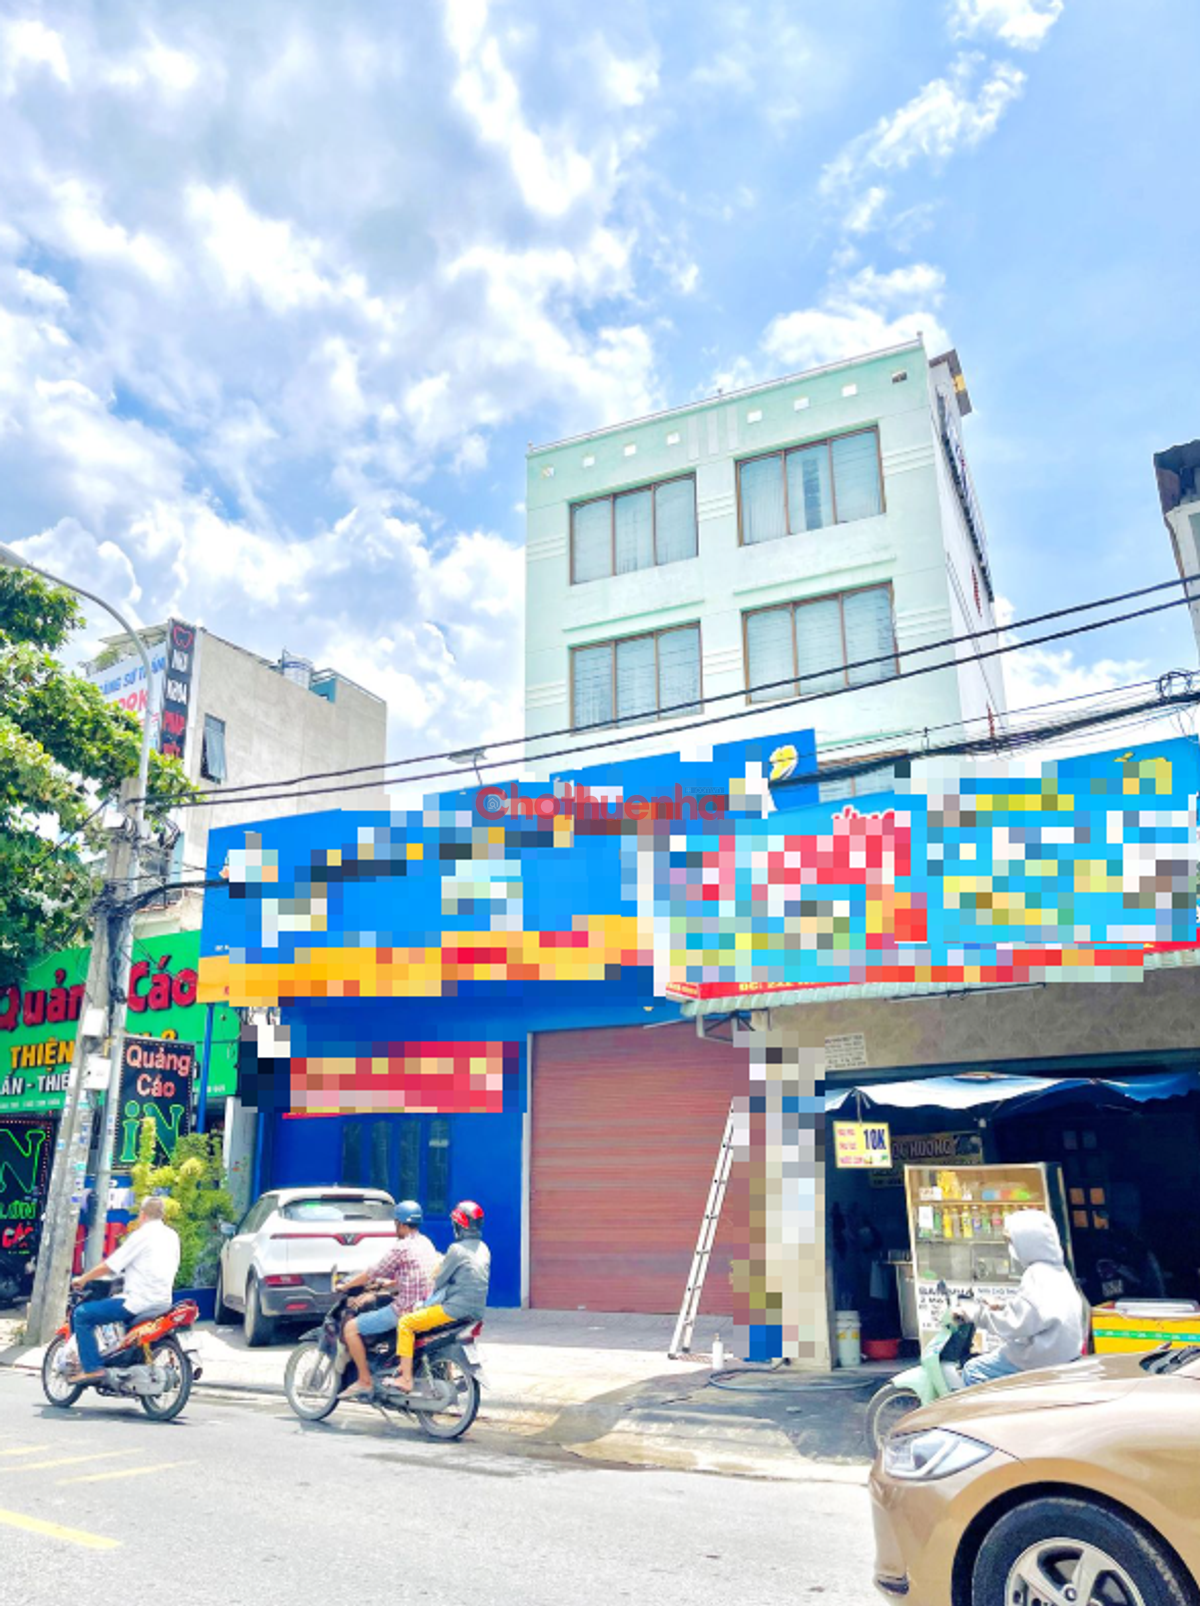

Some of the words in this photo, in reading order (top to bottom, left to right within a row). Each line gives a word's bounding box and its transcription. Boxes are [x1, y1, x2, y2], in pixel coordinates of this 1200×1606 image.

[0, 968, 86, 1033] Quản
[126, 955, 198, 1013] Cáo
[126, 1044, 191, 1077] Quảng
[136, 1073, 176, 1098] Cáo
[863, 1128, 887, 1150] 10K
